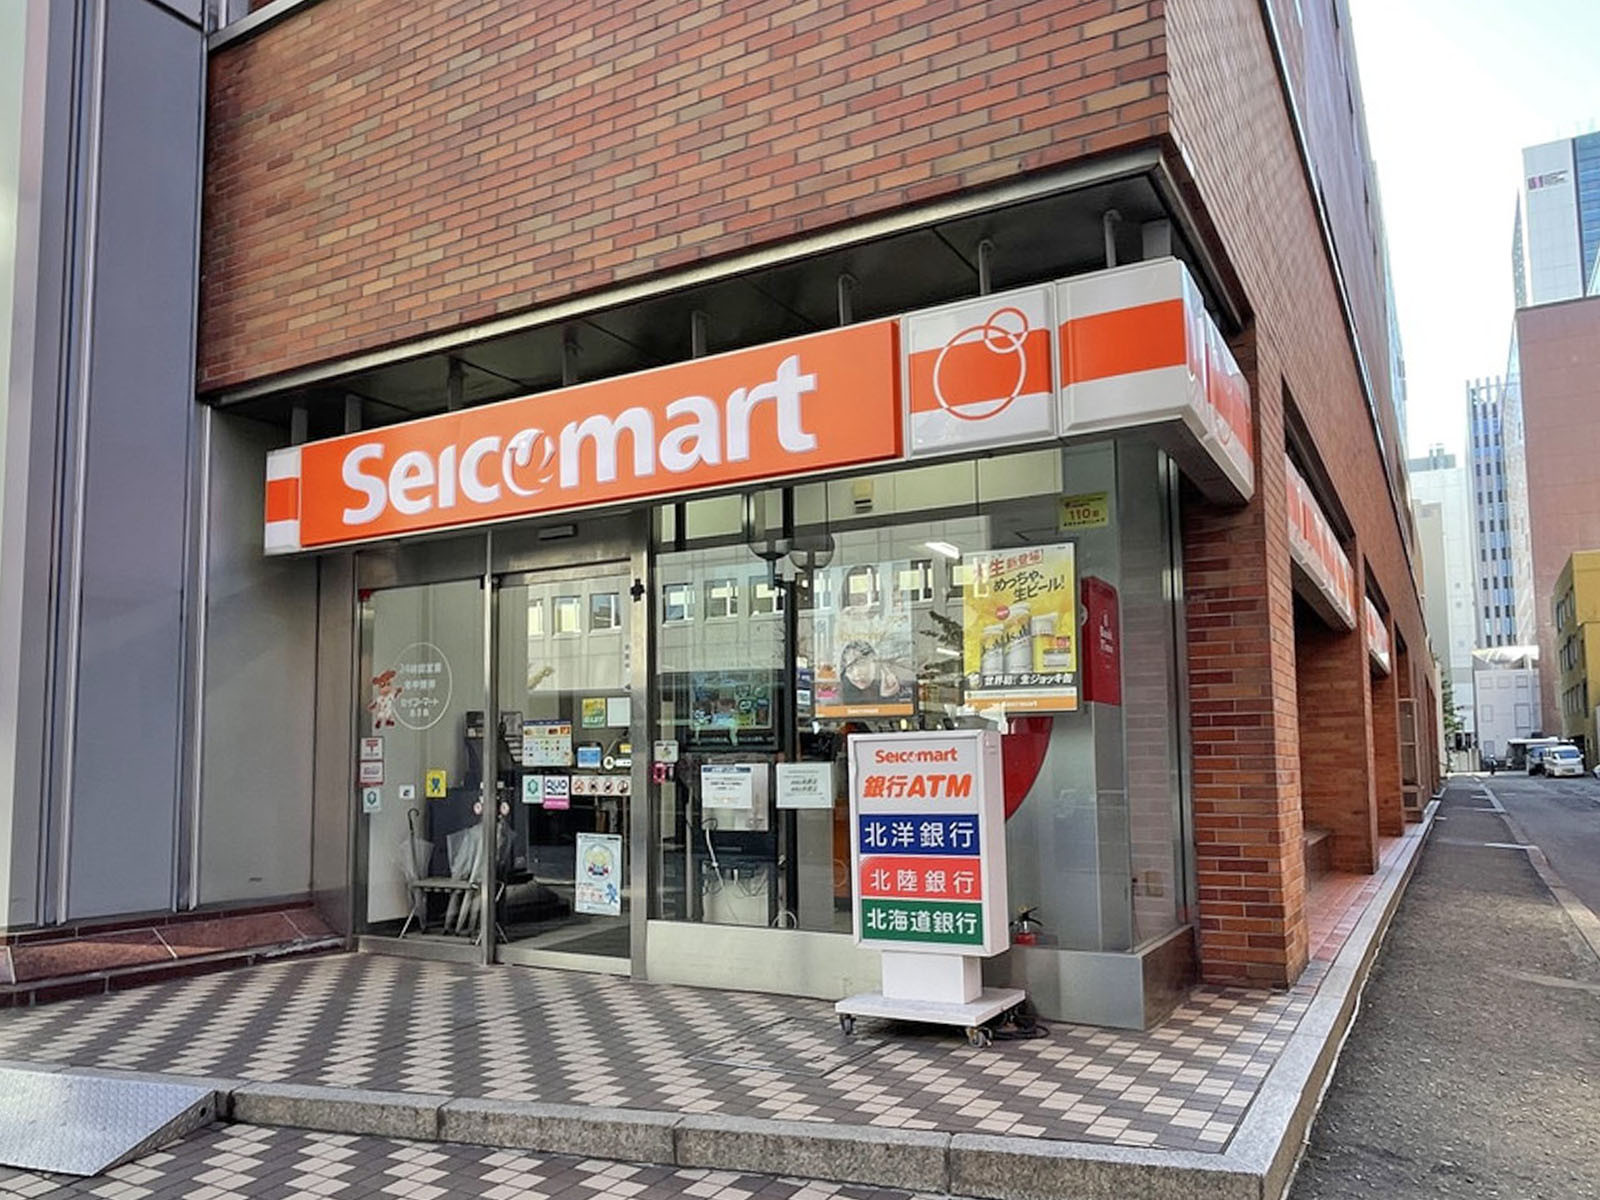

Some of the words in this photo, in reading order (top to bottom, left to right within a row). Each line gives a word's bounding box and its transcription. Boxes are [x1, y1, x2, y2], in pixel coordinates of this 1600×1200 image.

[341, 354, 818, 526] Seicomart
[875, 747, 958, 764] Seicomart
[863, 773, 972, 799] 銀行ATM
[864, 821, 975, 849] 北洋銀行
[870, 868, 975, 895] 北陸銀行
[866, 907, 978, 935] 北海道銀行
